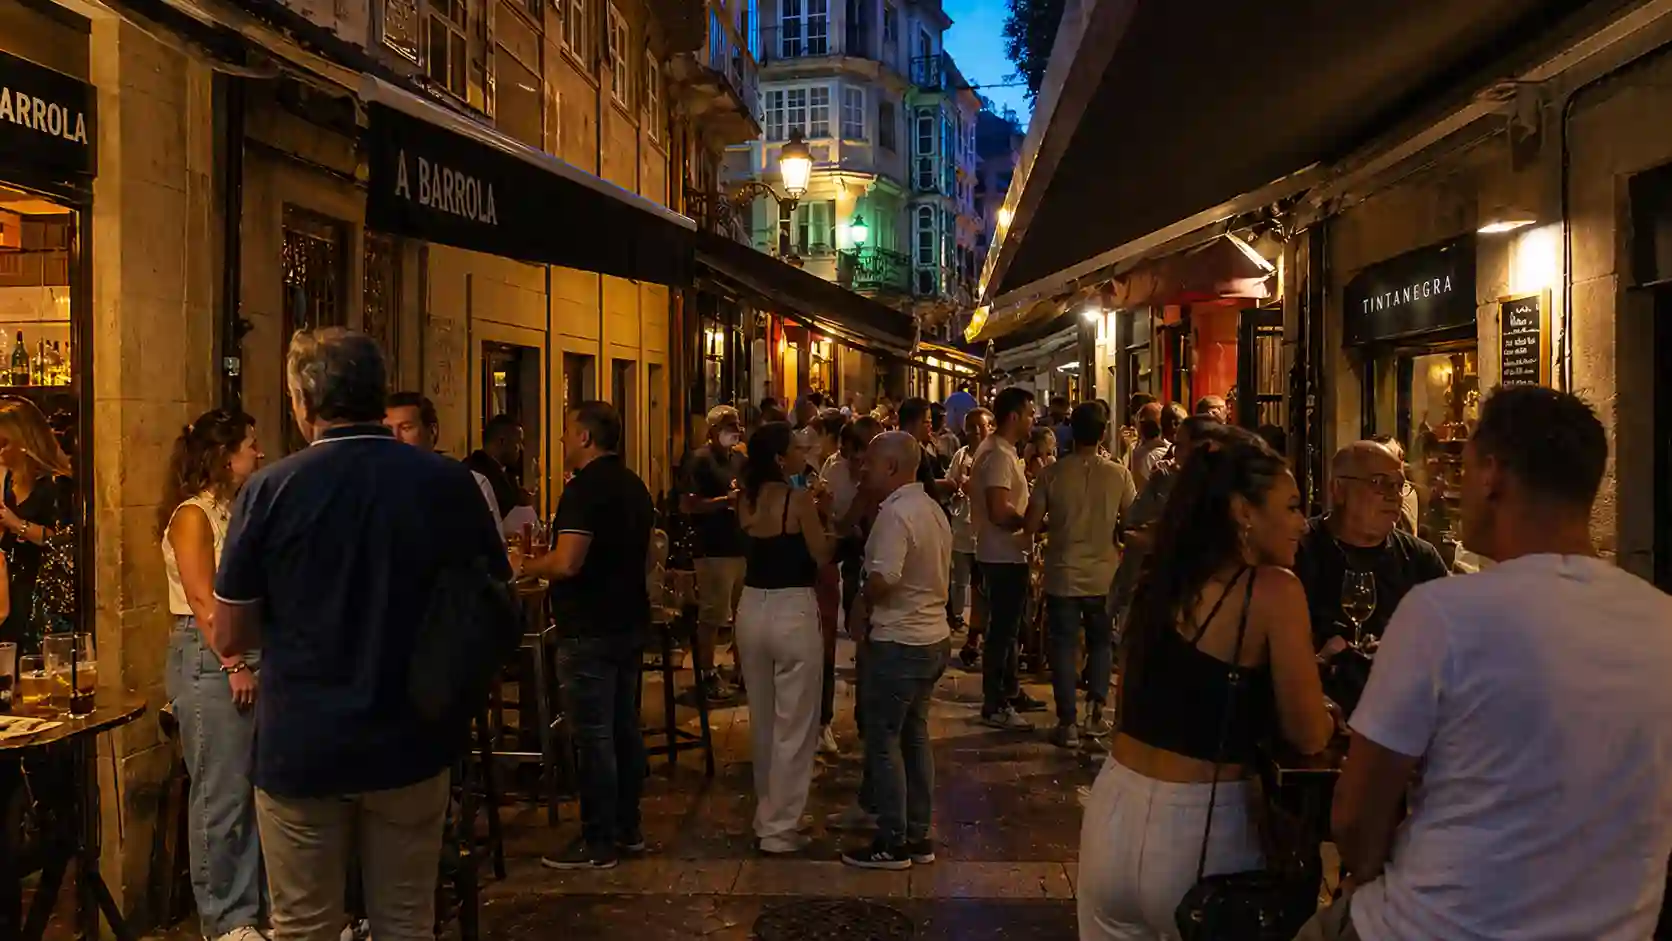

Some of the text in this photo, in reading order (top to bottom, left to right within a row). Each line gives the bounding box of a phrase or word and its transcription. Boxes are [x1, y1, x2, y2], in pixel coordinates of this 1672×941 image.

[0, 86, 88, 145] ARROLA
[394, 148, 499, 226] A BARROLA
[1363, 275, 1452, 314] TINTANEGRA
